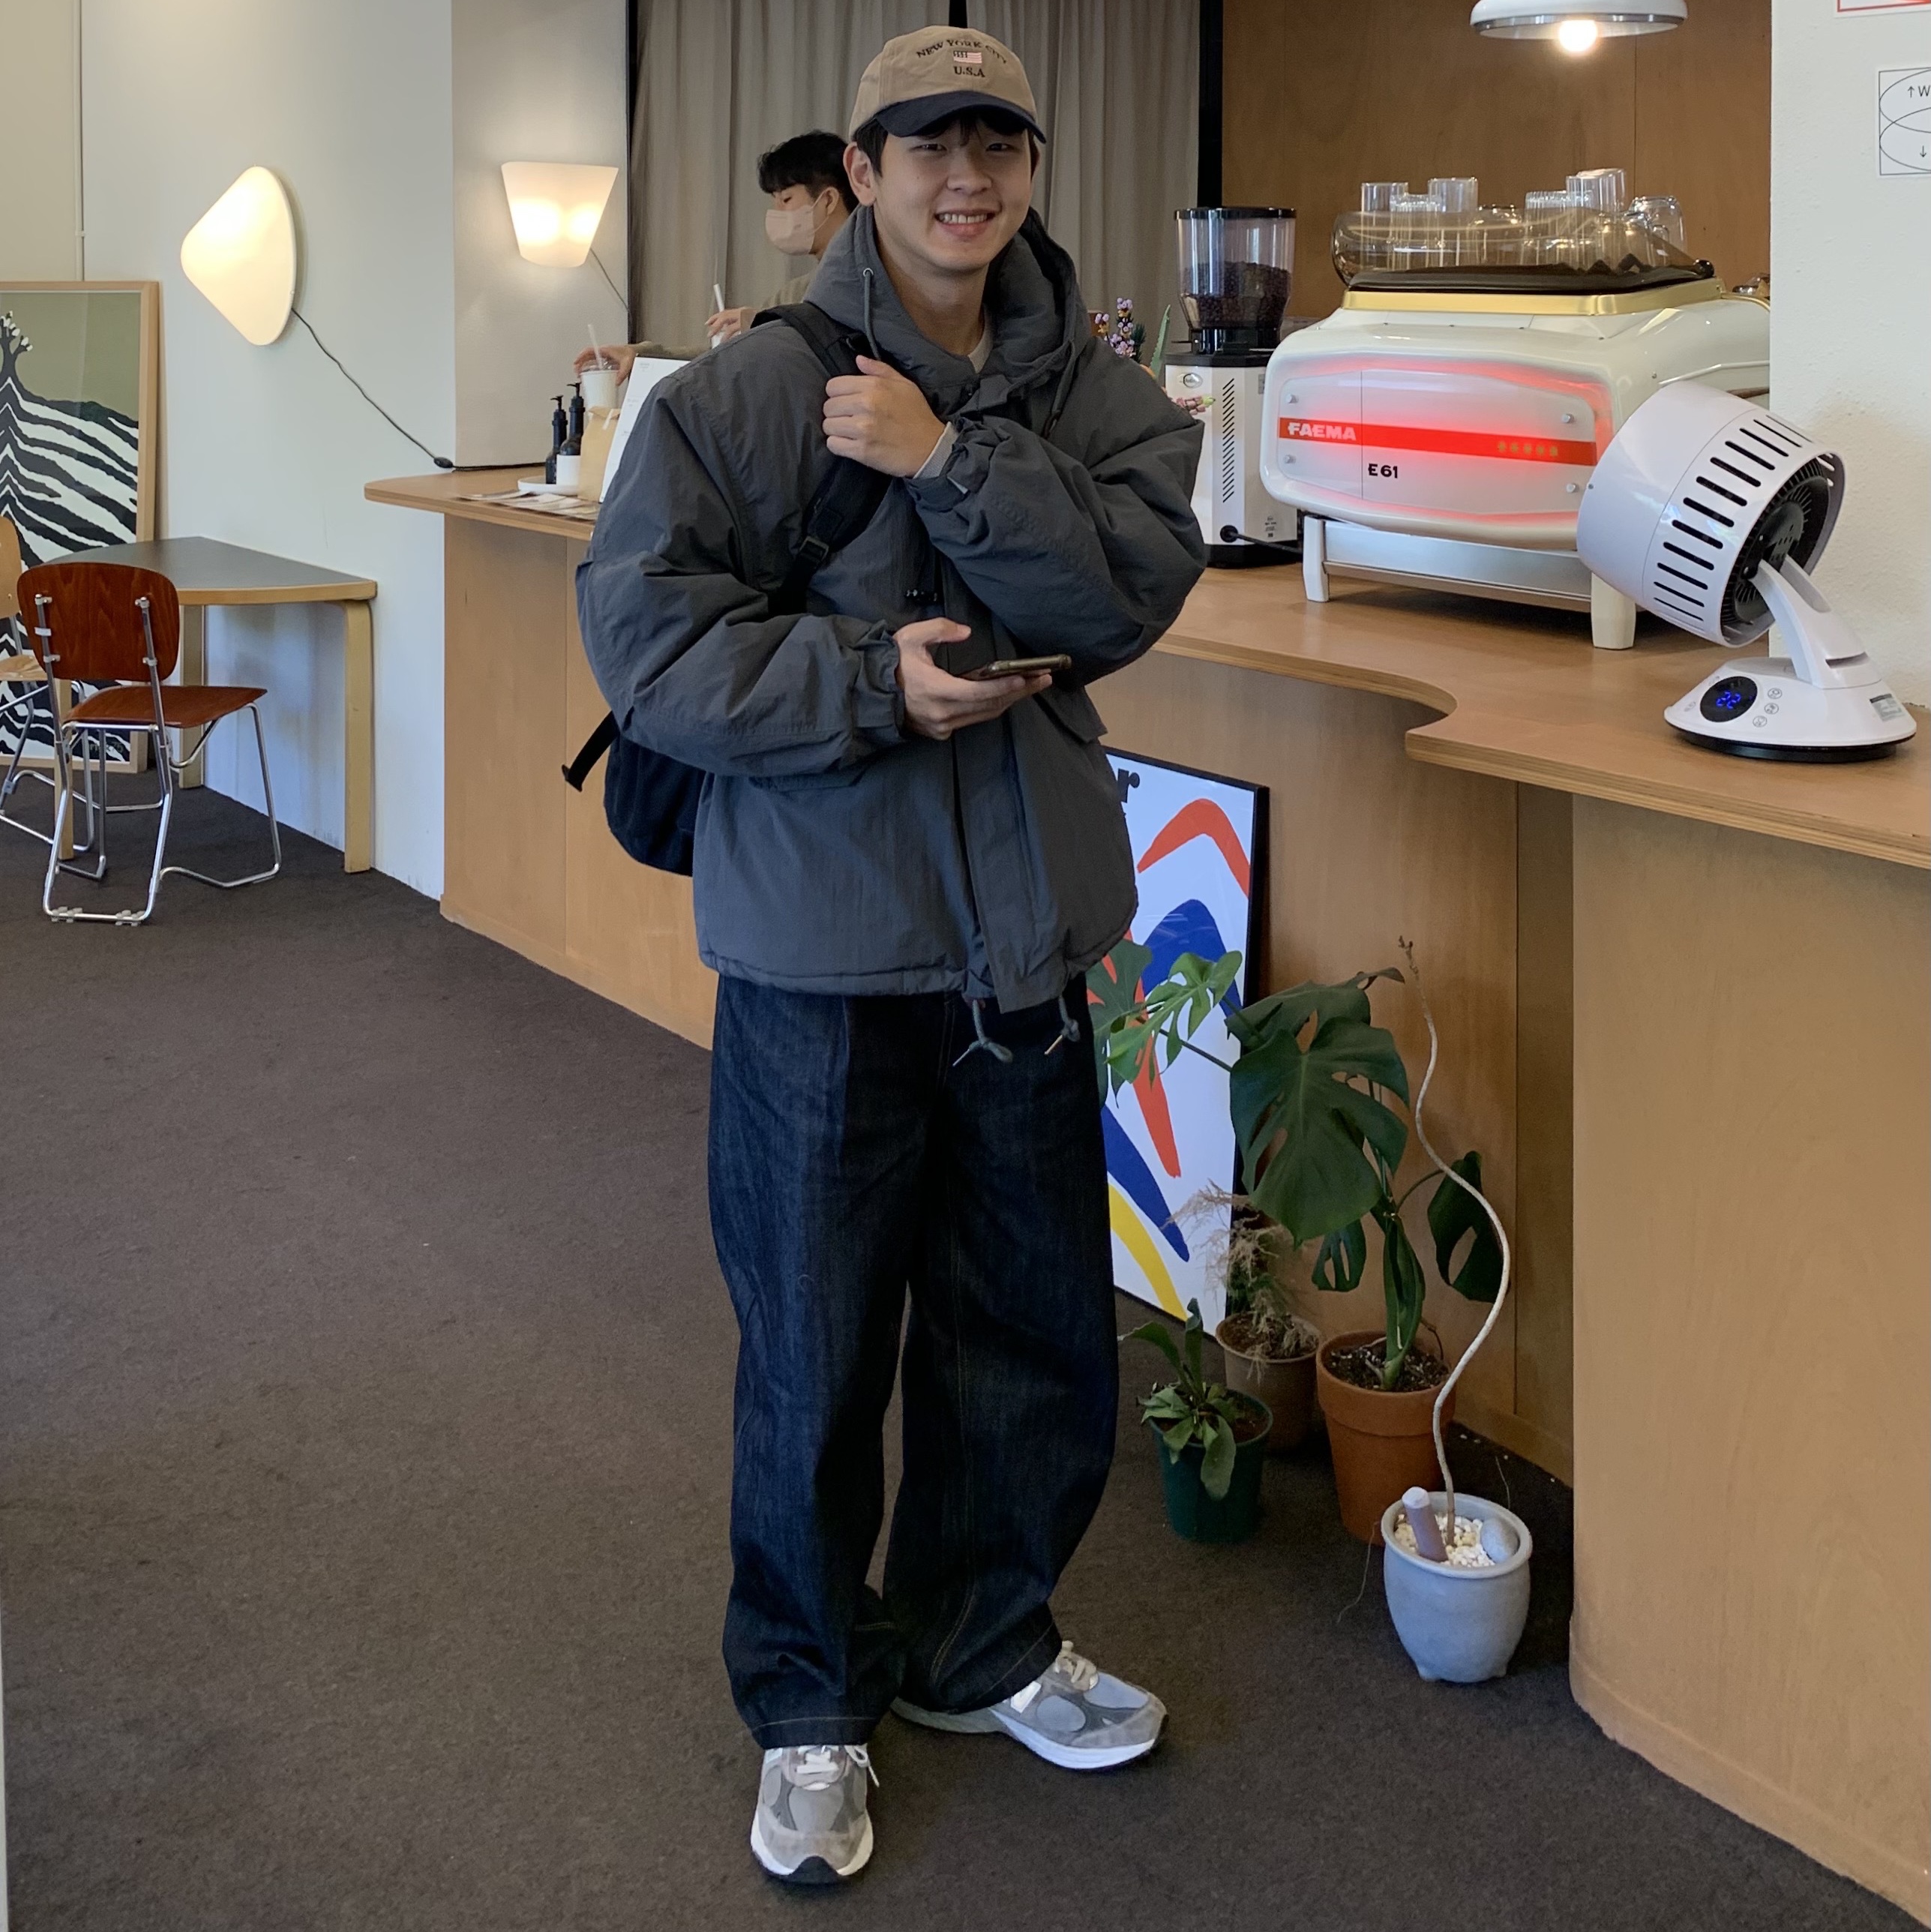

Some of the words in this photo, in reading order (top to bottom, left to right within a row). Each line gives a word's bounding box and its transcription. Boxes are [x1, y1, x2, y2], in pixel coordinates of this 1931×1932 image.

[916, 40, 944, 58] NEW
[946, 39, 982, 48] YORK
[1288, 422, 1357, 441] FAEMA
